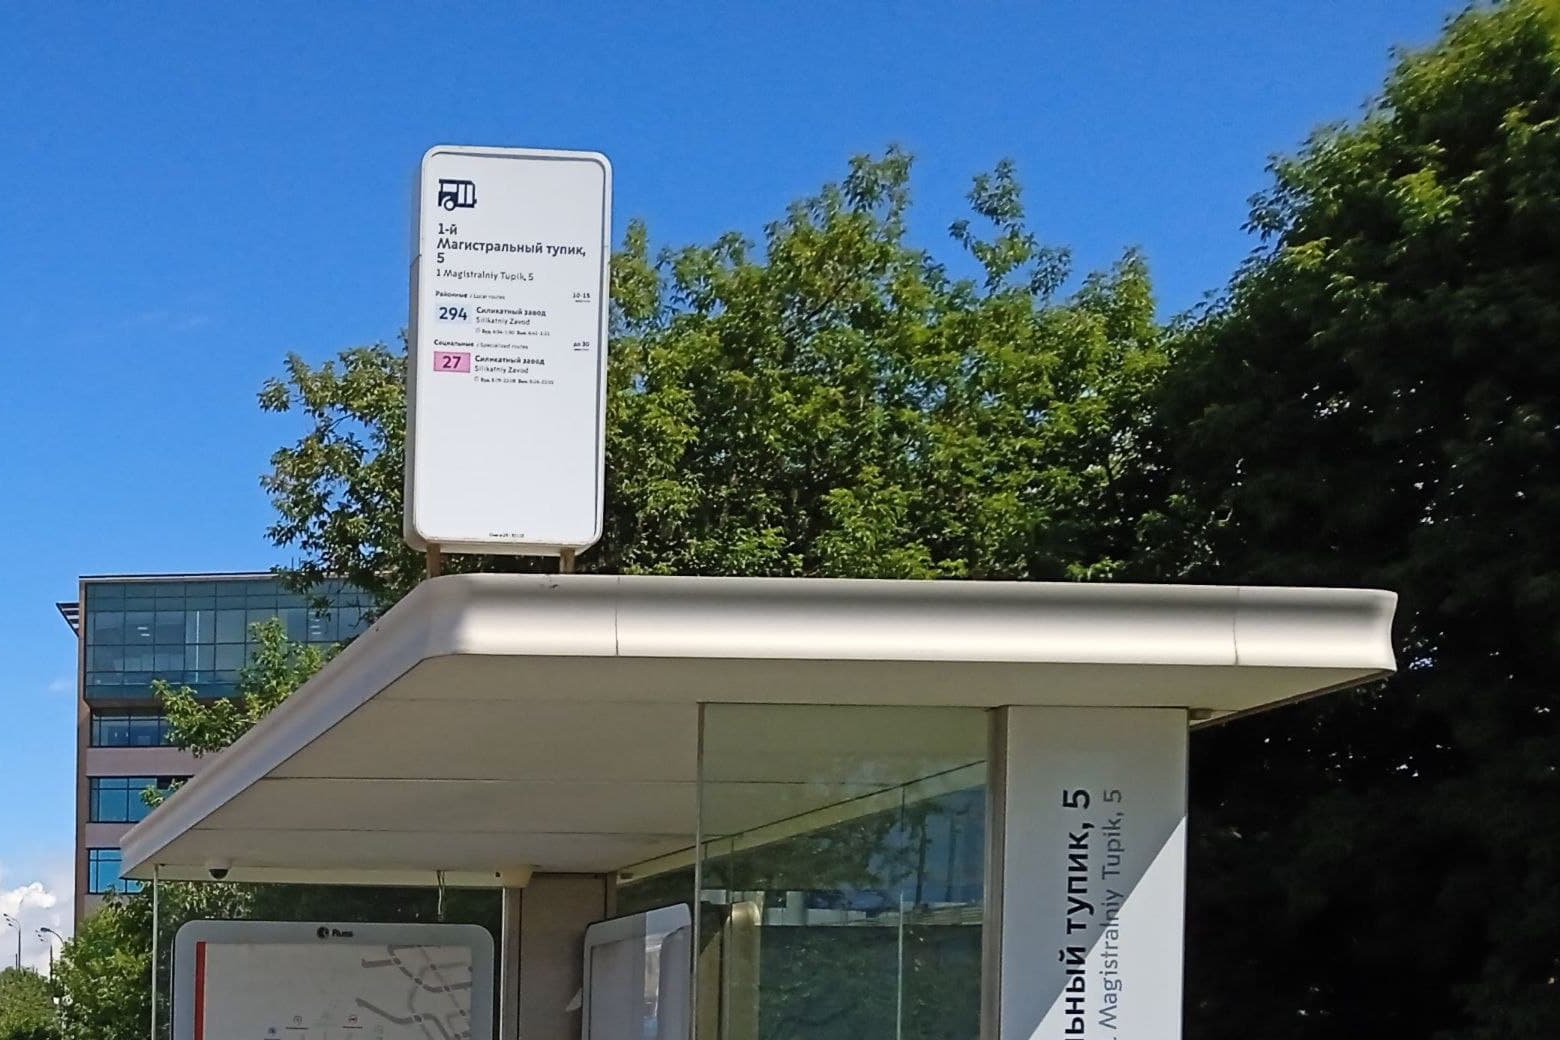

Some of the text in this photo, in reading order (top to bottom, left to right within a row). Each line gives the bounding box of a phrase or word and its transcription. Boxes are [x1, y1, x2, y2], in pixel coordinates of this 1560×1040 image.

[438, 222, 458, 236] 1-й
[436, 238, 586, 258] Магистральный тупик,
[436, 252, 445, 264] 5
[436, 269, 534, 282] 1 Magistralniy Tupik, 5
[439, 306, 468, 321] 294
[476, 306, 547, 317] Силикатный завод
[442, 355, 462, 370] 27
[474, 355, 521, 365] Силикатный
[1062, 788, 1090, 810] 5
[1103, 788, 1122, 803] 5
[1101, 812, 1125, 880] Tupik,
[1066, 822, 1095, 935] тупик,
[1098, 889, 1125, 1030] Magistralniy
